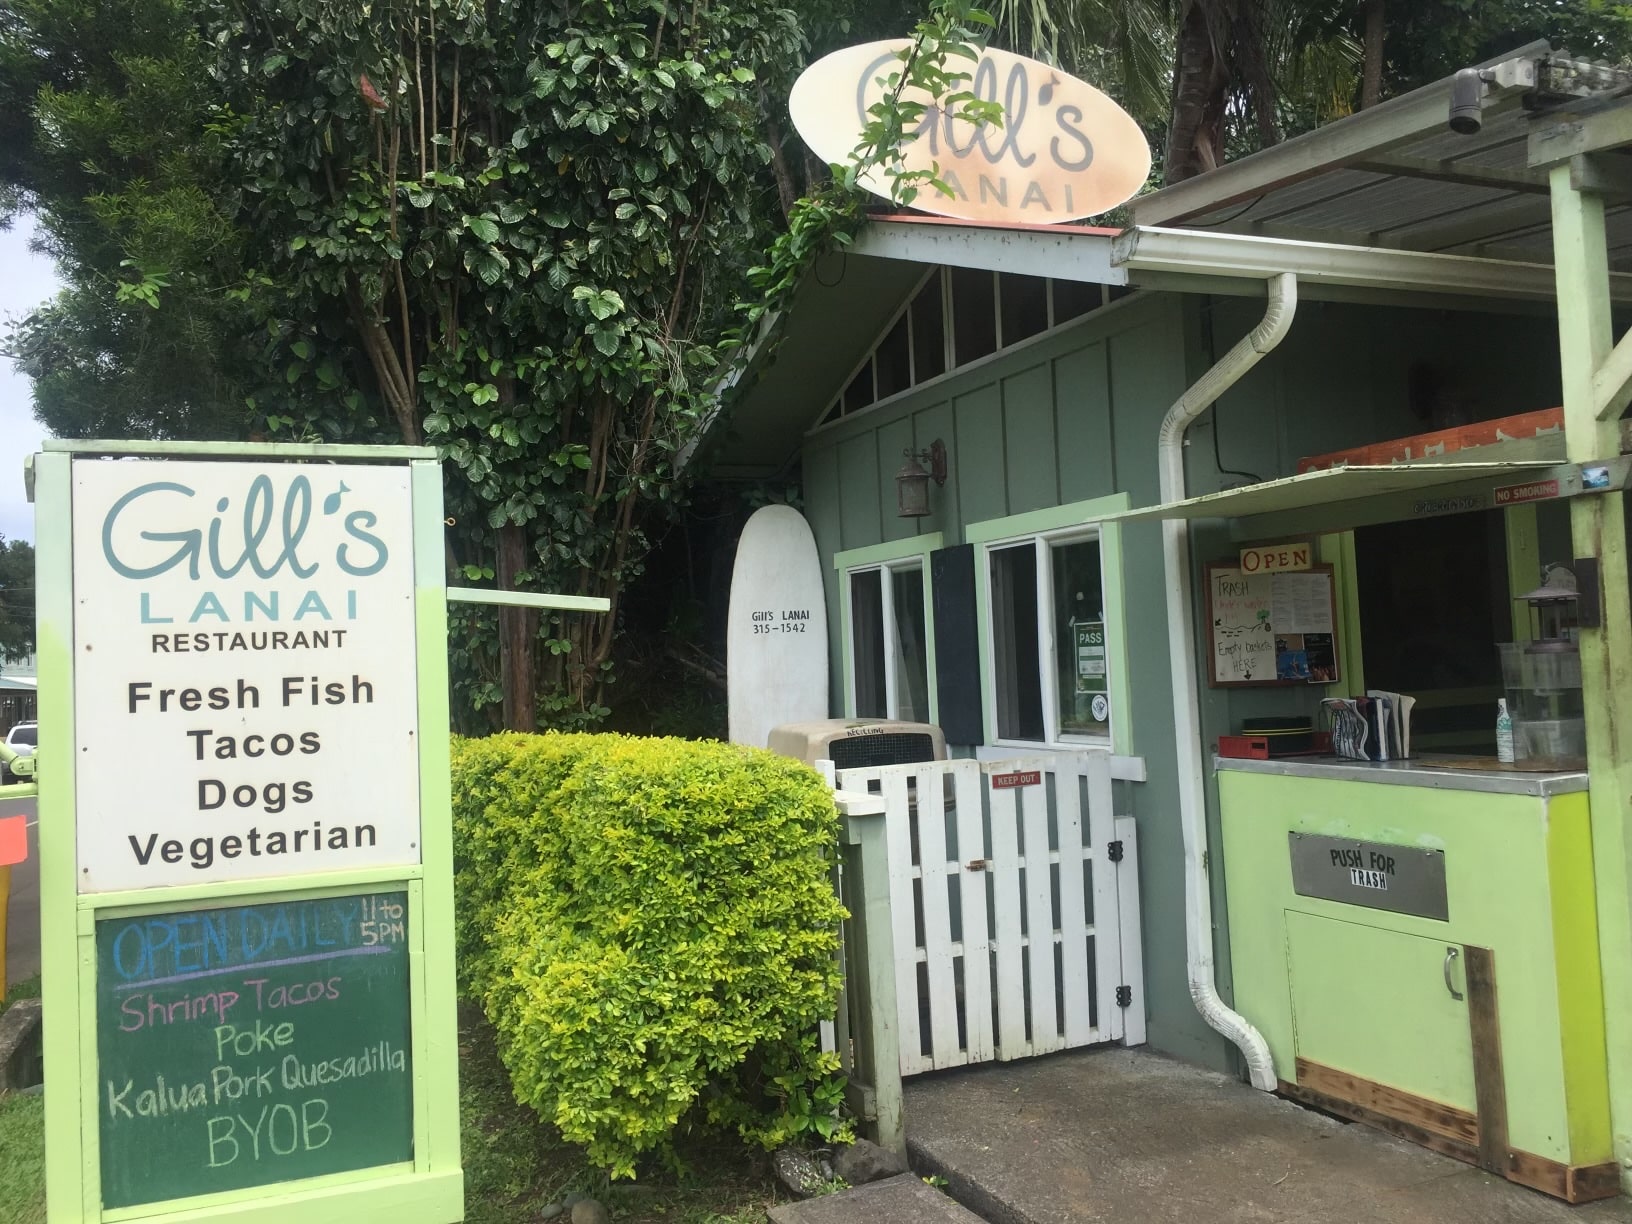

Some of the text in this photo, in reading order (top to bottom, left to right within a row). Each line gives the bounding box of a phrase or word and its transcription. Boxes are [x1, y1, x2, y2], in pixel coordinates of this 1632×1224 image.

[899, 169, 1075, 213] ANAI
[1497, 483, 1556, 501] NO SMOKING
[102, 474, 389, 581] Gill's
[140, 590, 357, 625] LANAI
[782, 609, 810, 620] LANAI
[151, 630, 347, 653] RESTAURANT
[1079, 632, 1102, 644] PASS
[1232, 657, 1257, 673] HERE
[128, 675, 374, 714] Fresh Fish
[187, 730, 321, 761] Tacos
[198, 779, 313, 814] Dogs
[997, 774, 1035, 785] KEEP OUT
[128, 820, 376, 870] Vegetarian
[1330, 849, 1395, 875] PUSH FOR
[1351, 868, 1386, 889] TRASH
[113, 903, 359, 980] OPEN DAILY
[361, 920, 405, 946] 5PM
[119, 976, 342, 1032] Shrimp Tacos
[214, 1020, 295, 1061] Poke
[107, 1040, 406, 1119] Kalua Pork Quesadilla
[206, 1099, 333, 1169] BYOB
